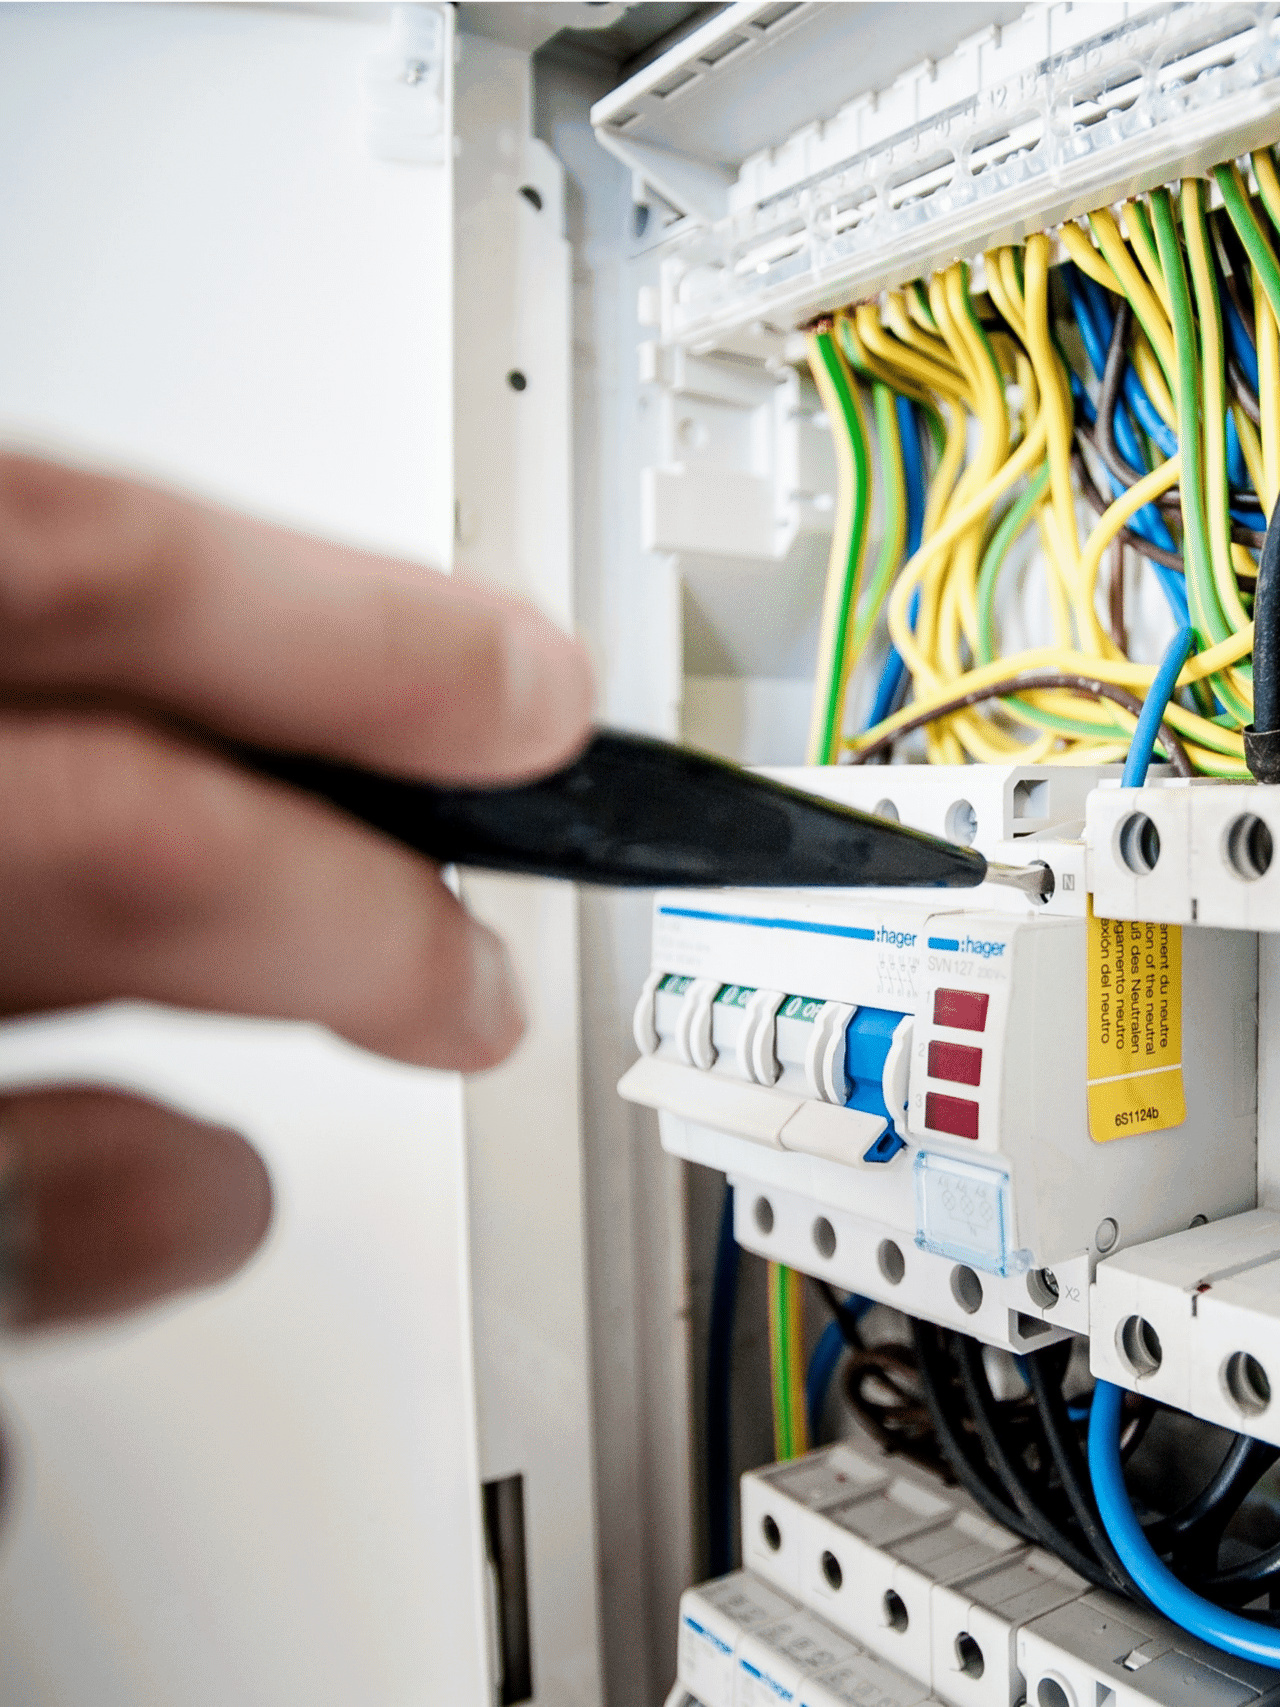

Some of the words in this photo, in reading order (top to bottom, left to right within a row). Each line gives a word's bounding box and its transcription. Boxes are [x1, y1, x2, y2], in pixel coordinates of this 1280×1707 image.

[927, 955, 952, 974] SVN
[954, 960, 974, 977] 127
[1131, 945, 1141, 974] des
[1146, 954, 1156, 969] of
[1101, 963, 1112, 987] del
[1146, 974, 1156, 998] the
[1160, 974, 1170, 994] du
[1101, 992, 1111, 1044] neutro
[1116, 999, 1125, 1049] neutro
[1131, 979, 1141, 1054] Neutralen
[1160, 999, 1169, 1048] neutre
[1146, 1003, 1156, 1055] neutral
[1115, 1107, 1159, 1126] 6S1124b
[1065, 1285, 1080, 1302] X2
